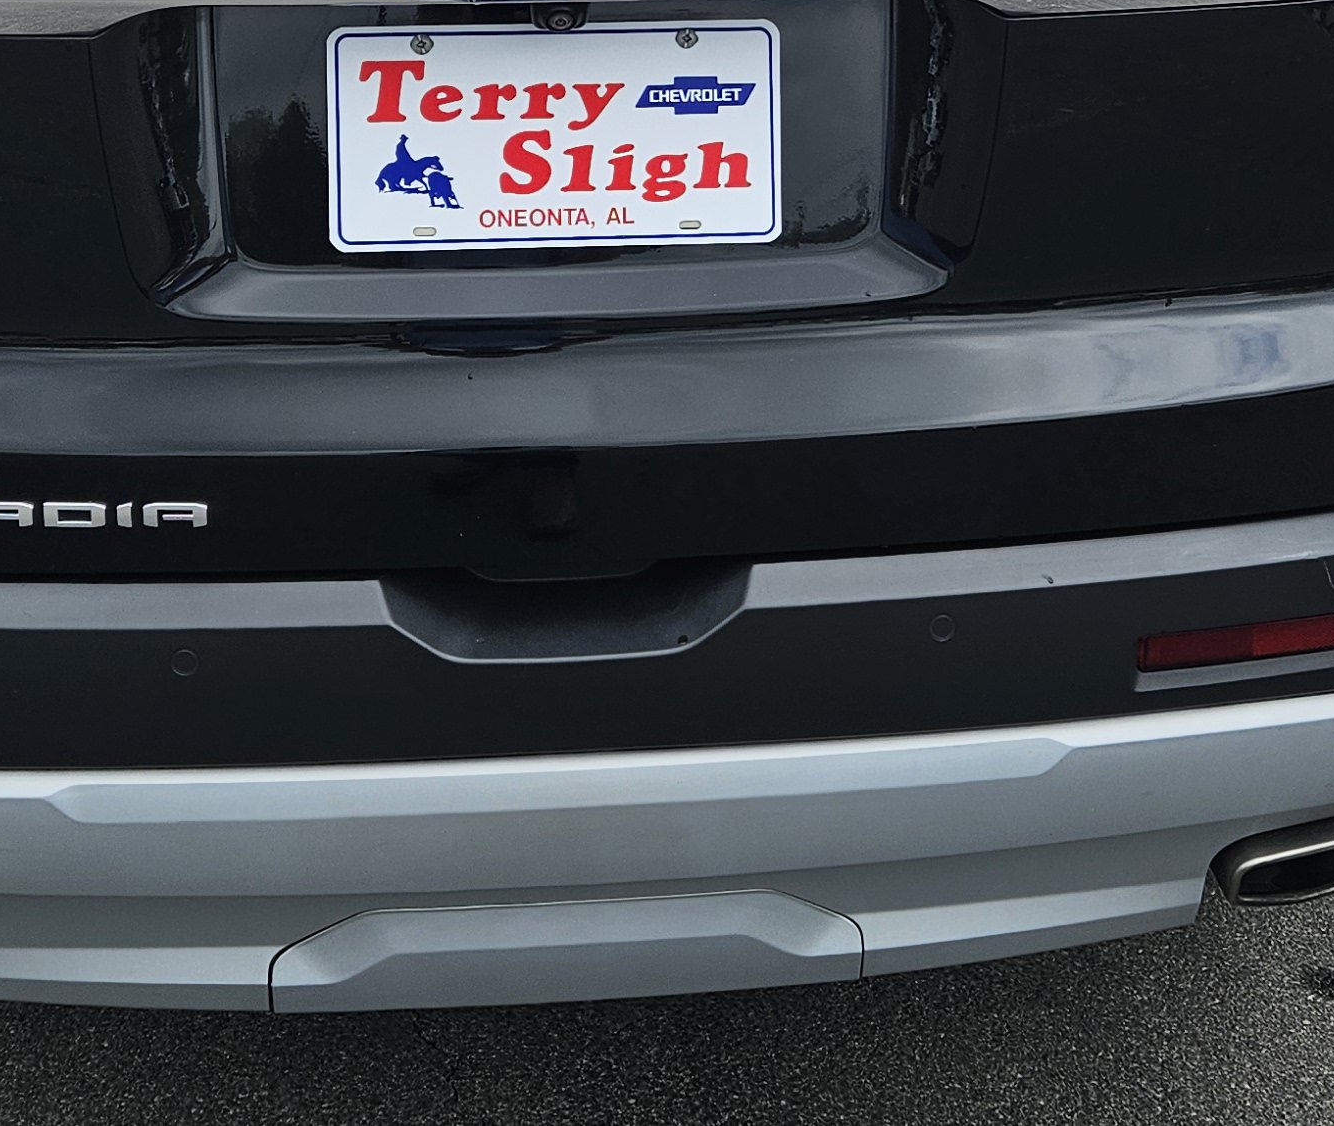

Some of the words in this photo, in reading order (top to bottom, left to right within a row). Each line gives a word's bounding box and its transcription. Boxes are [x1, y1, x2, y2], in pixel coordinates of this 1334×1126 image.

[359, 60, 625, 131] Terry
[648, 87, 743, 104] CHEVROLET
[499, 129, 752, 203] Sligh
[479, 208, 596, 229] ONEONTA,
[606, 206, 635, 225] AL
